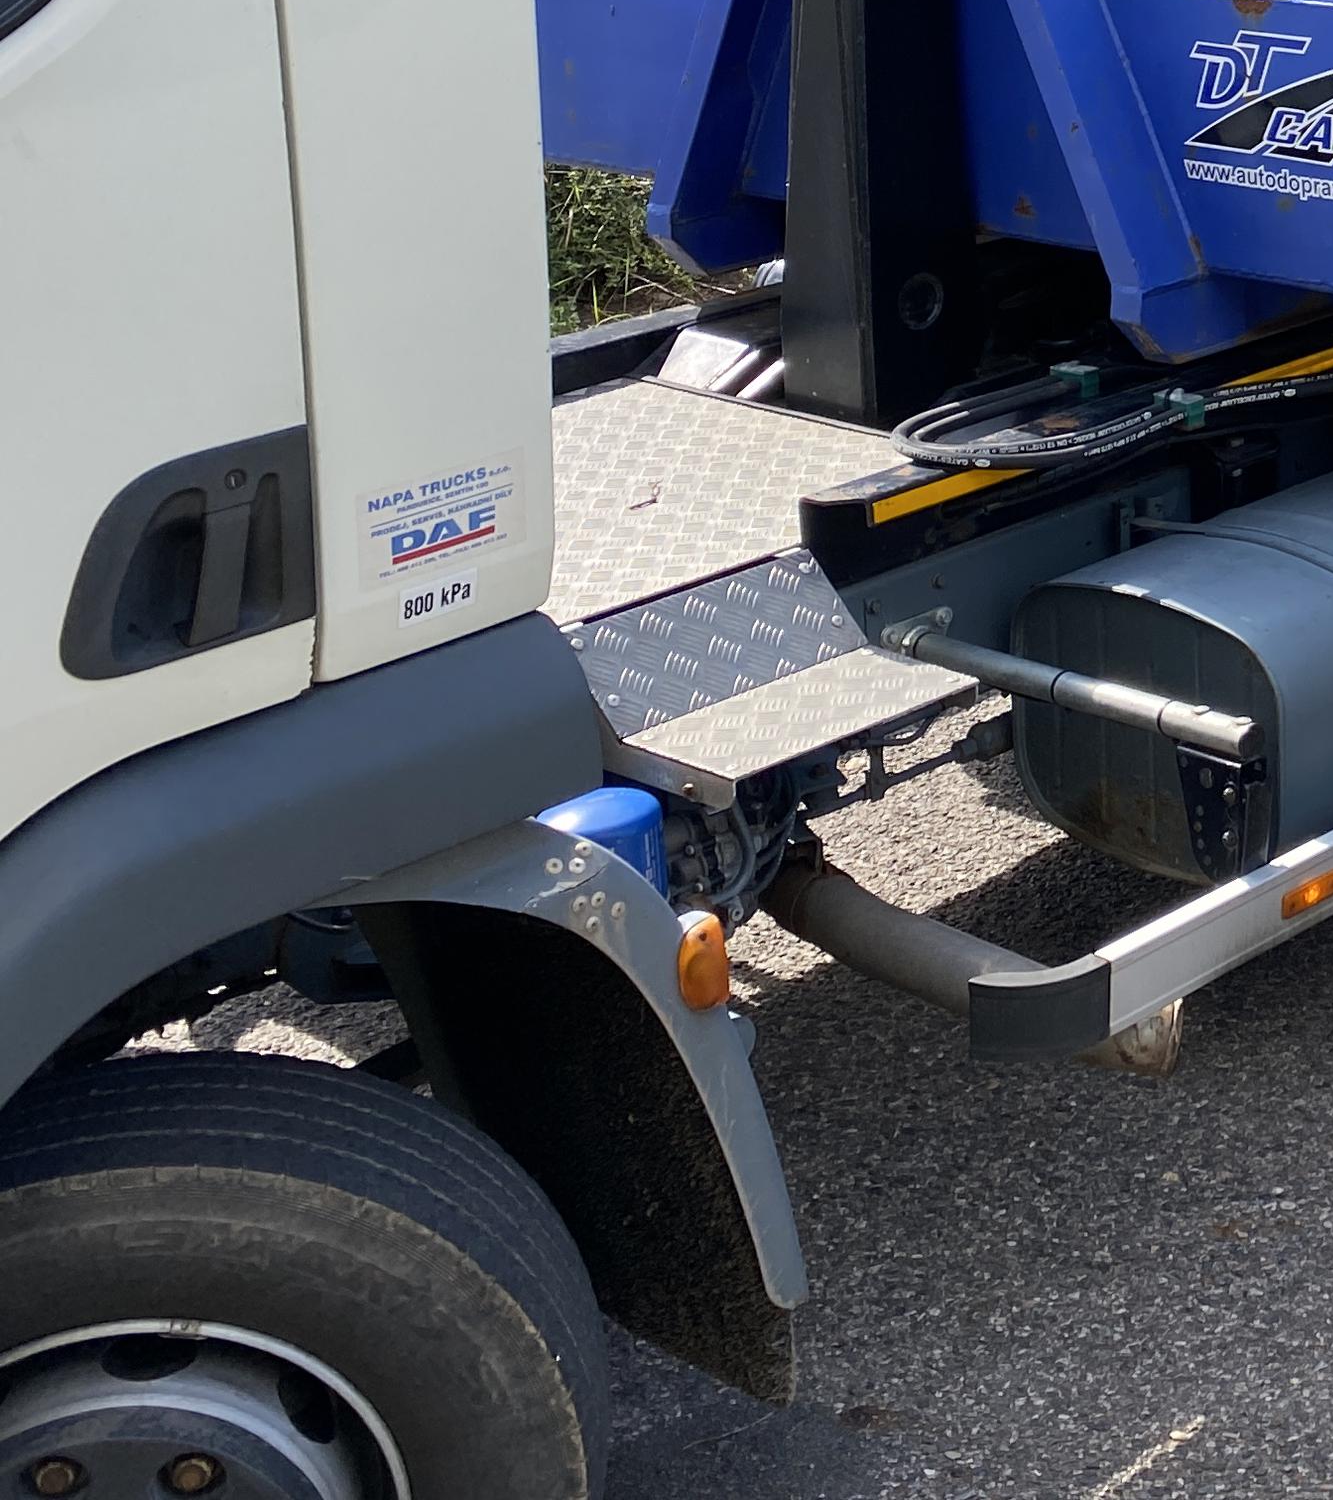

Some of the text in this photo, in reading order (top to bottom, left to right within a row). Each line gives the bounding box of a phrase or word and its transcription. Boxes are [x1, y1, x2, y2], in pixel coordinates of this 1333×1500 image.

[1189, 30, 1312, 108] DT
[368, 489, 414, 513] NAPA
[418, 467, 486, 497] TRUCKS
[391, 504, 496, 556] DAF
[404, 582, 471, 620] 800 kPa
